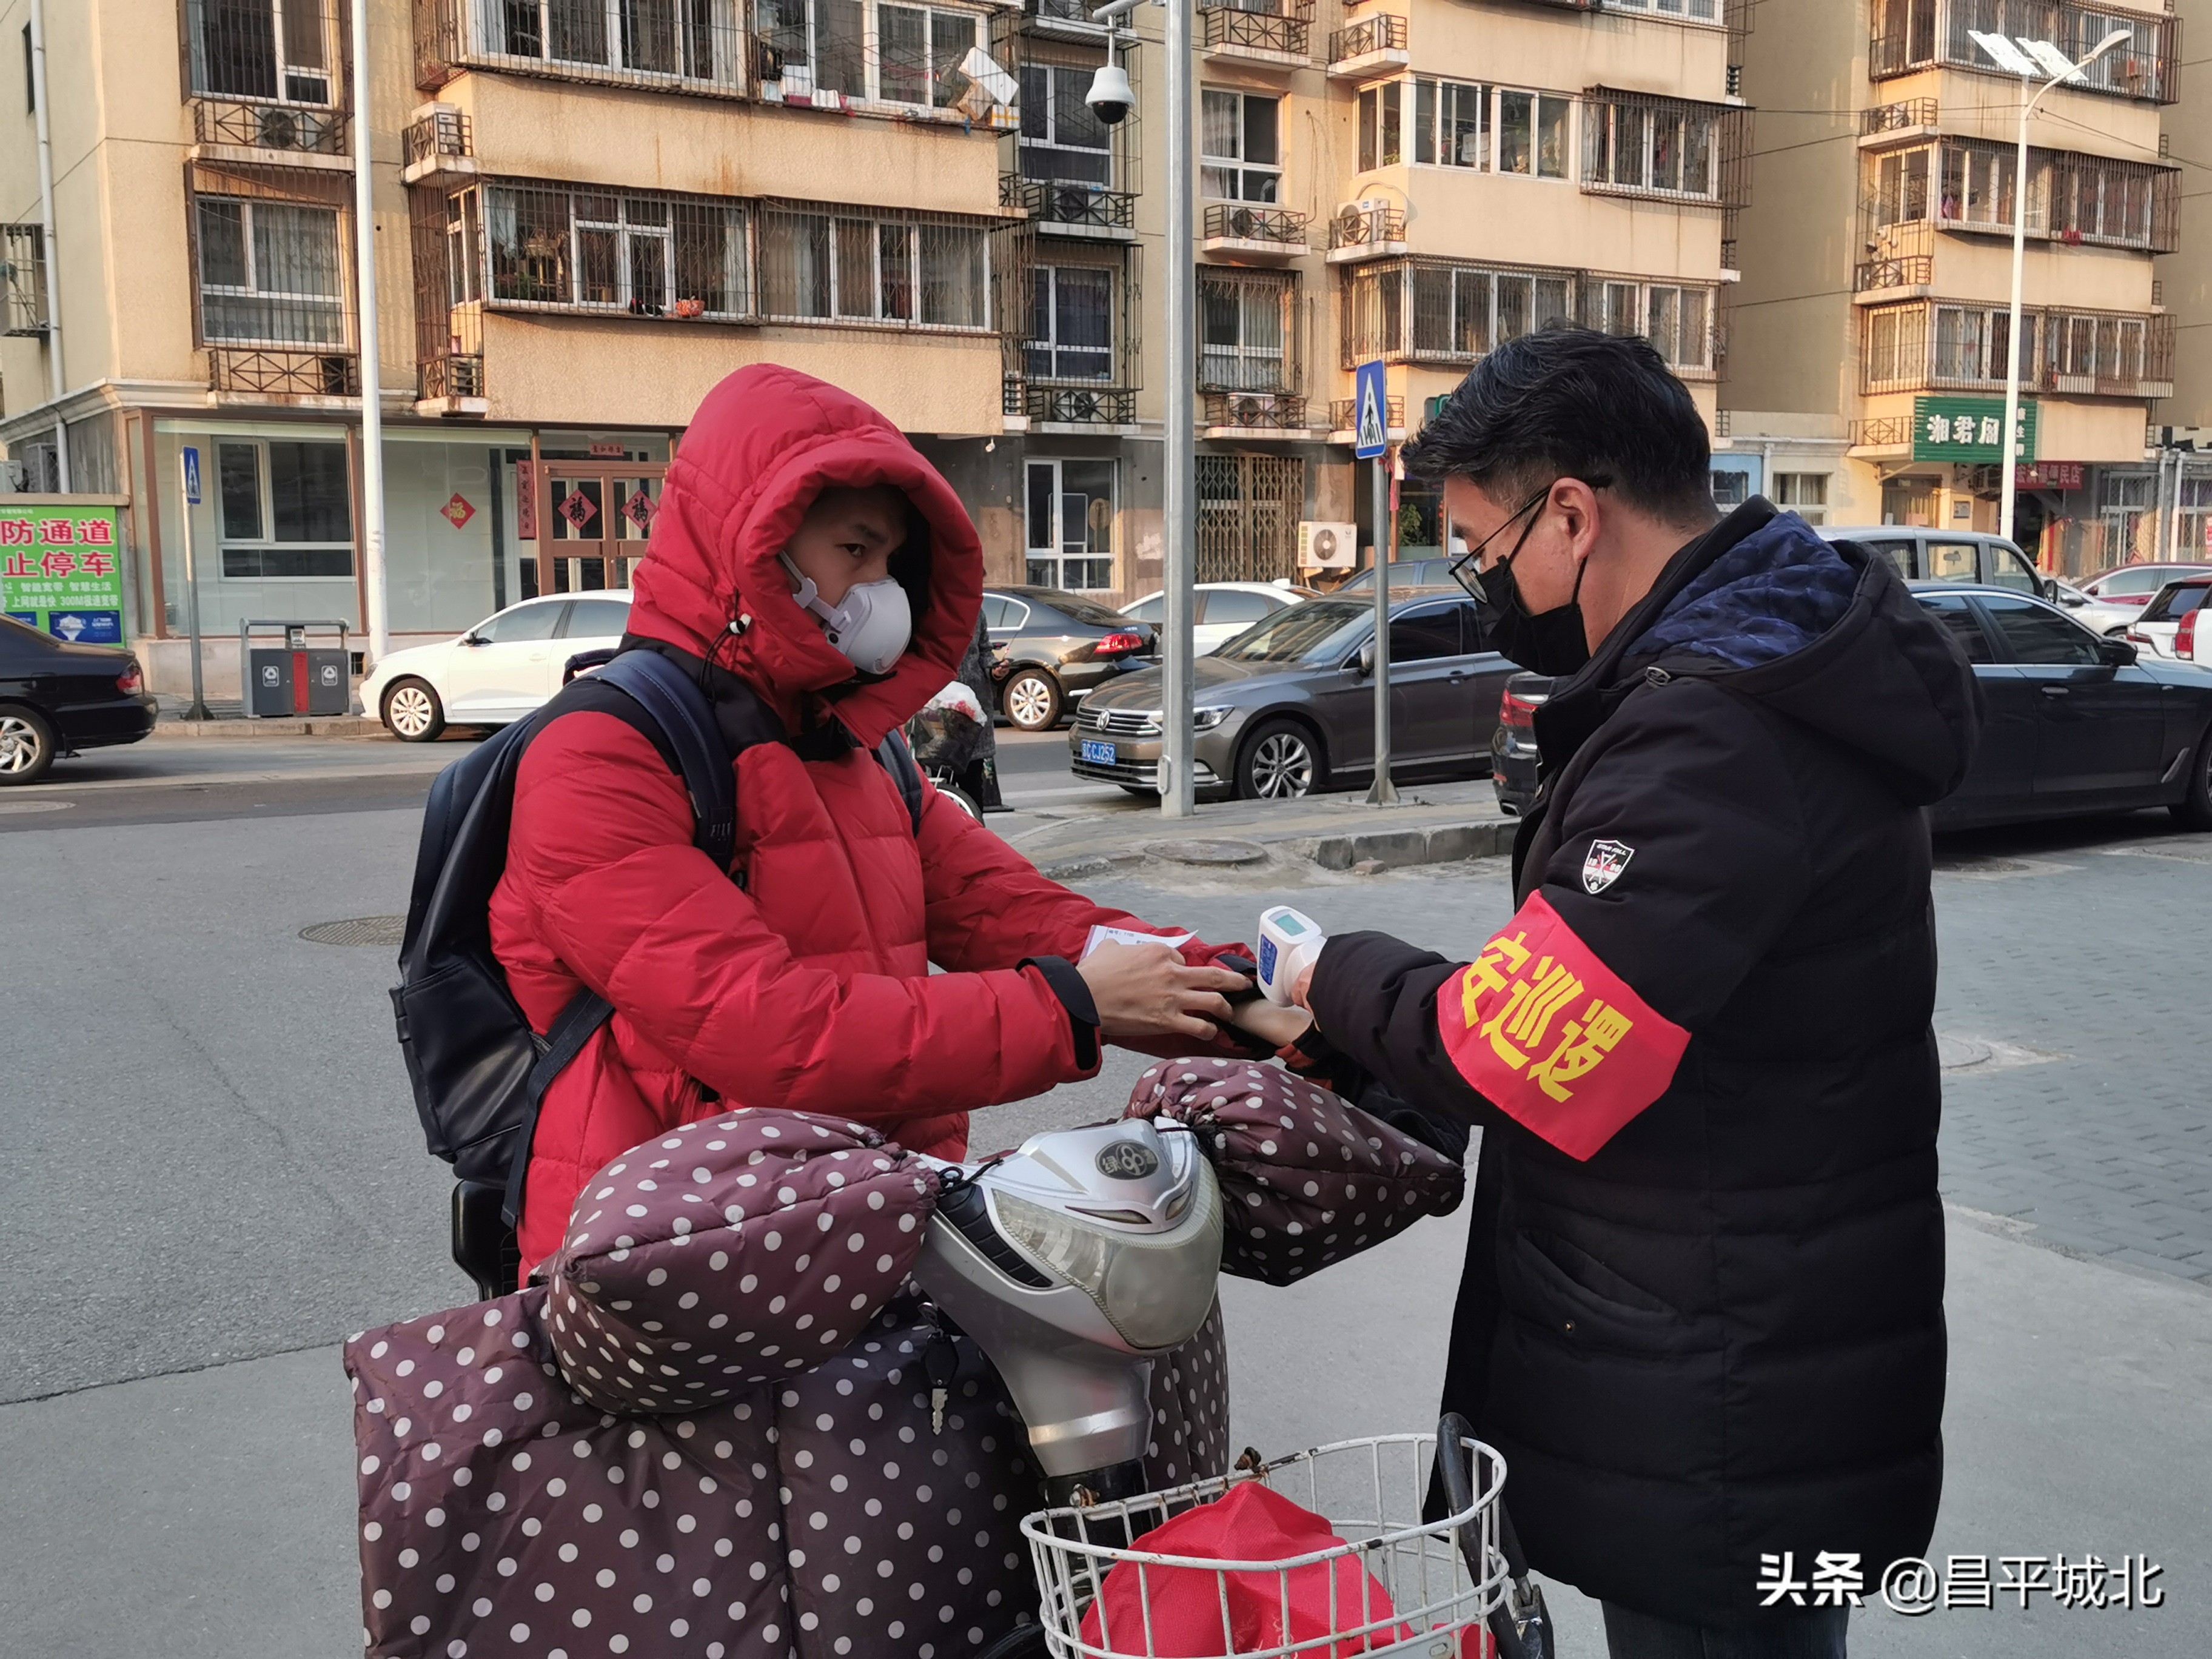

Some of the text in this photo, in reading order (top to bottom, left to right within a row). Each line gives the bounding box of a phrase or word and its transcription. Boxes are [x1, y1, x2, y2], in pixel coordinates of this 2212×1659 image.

[569, 496, 586, 523] 福
[632, 495, 649, 523] 福
[0, 518, 114, 546] 防通道
[2, 551, 115, 578] 止停车
